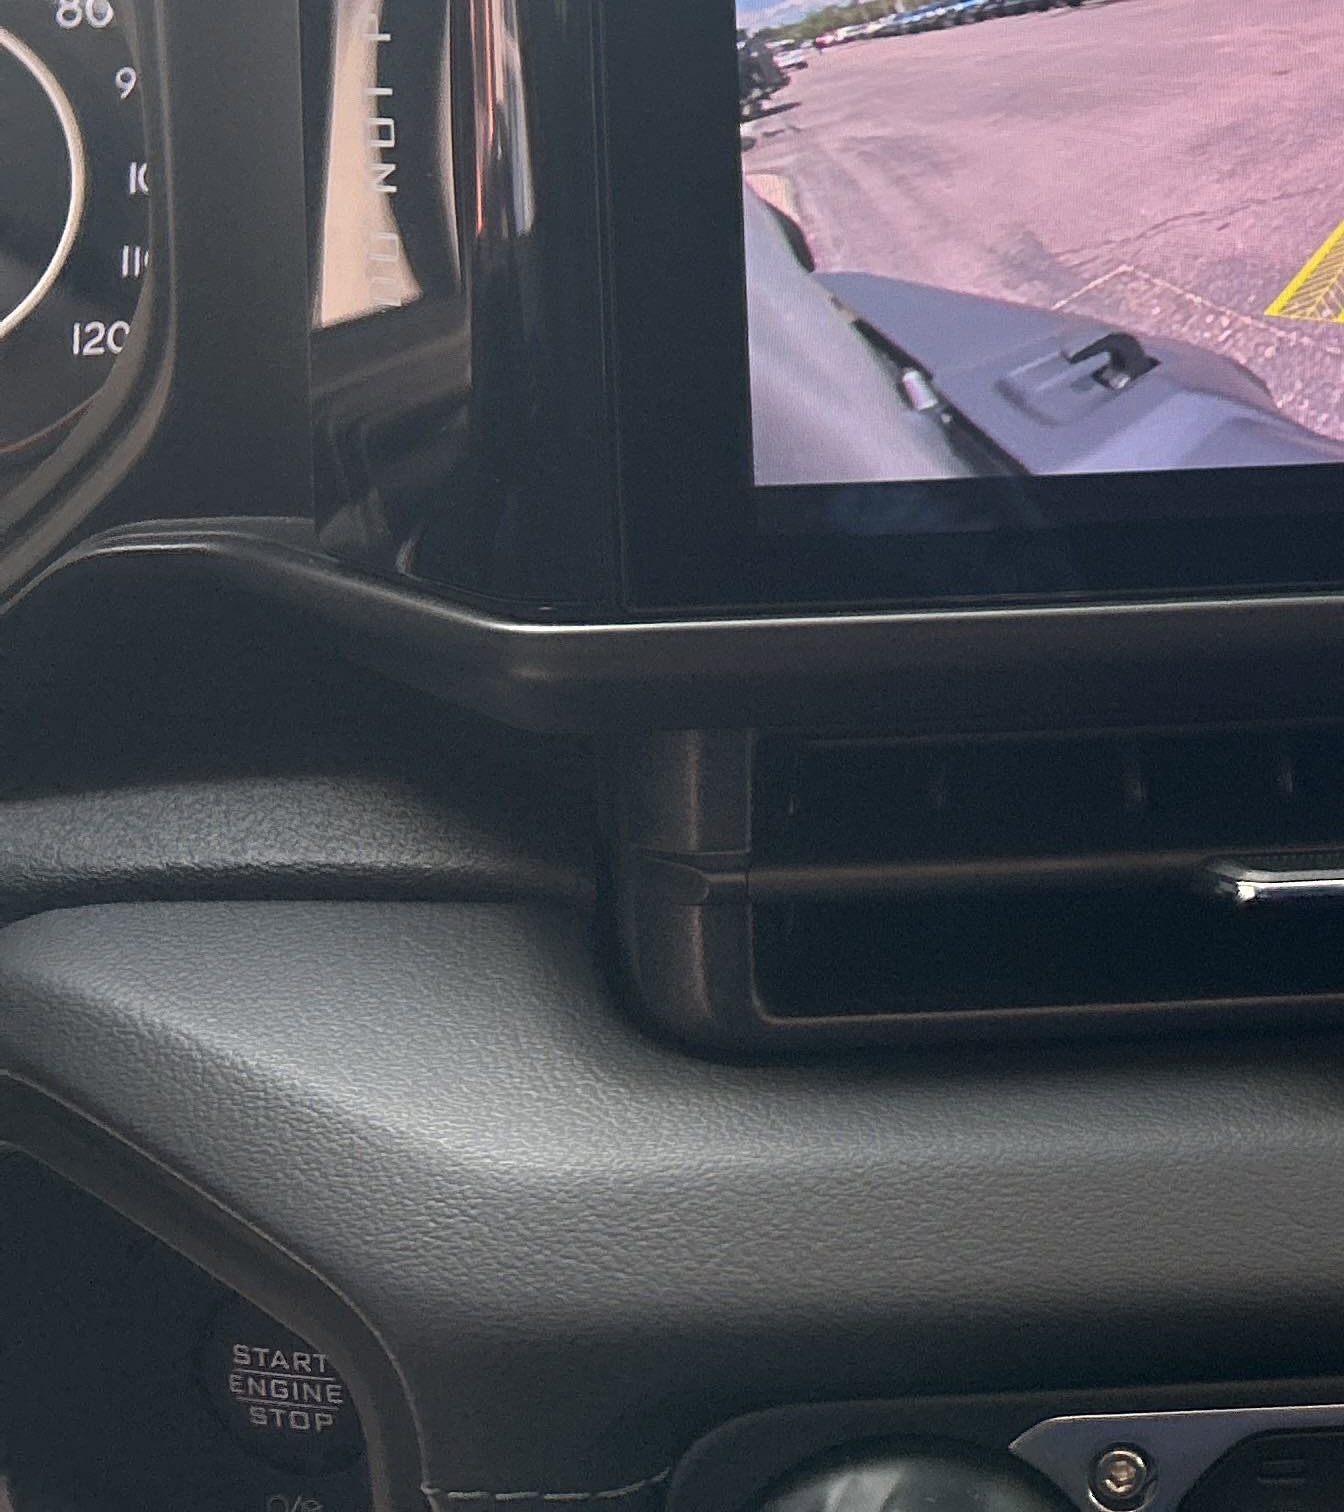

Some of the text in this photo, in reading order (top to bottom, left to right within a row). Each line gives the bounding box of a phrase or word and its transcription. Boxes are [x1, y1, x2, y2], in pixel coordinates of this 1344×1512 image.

[115, 66, 137, 100] 9
[122, 245, 149, 278] 11
[233, 1343, 327, 1373] START
[229, 1373, 343, 1403] ENGINE
[249, 1406, 334, 1432] STOP
